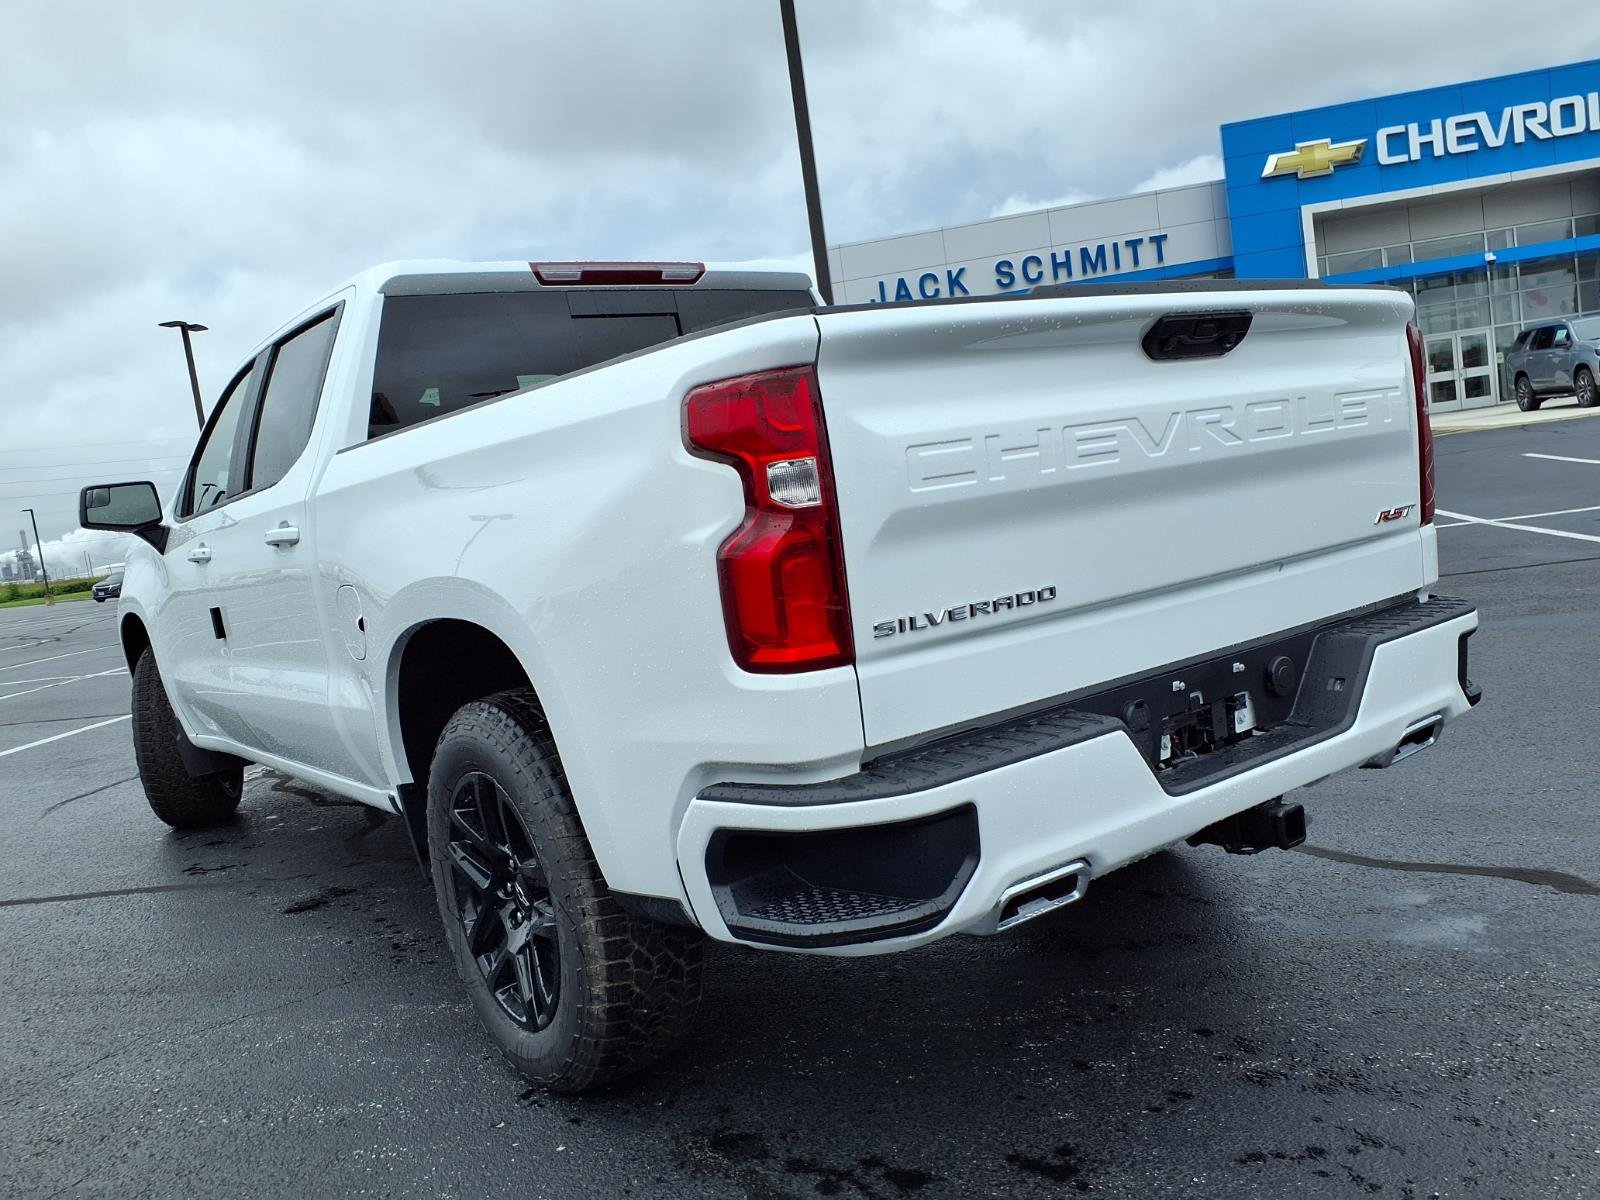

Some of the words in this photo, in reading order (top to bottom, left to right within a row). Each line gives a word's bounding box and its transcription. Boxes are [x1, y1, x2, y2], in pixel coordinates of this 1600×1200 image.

[870, 267, 970, 302] JACK
[994, 233, 1168, 288] SCHMITT
[905, 386, 1401, 492] CHEVROLET
[1373, 503, 1416, 525] RST
[873, 585, 1057, 638] SILVERADO
